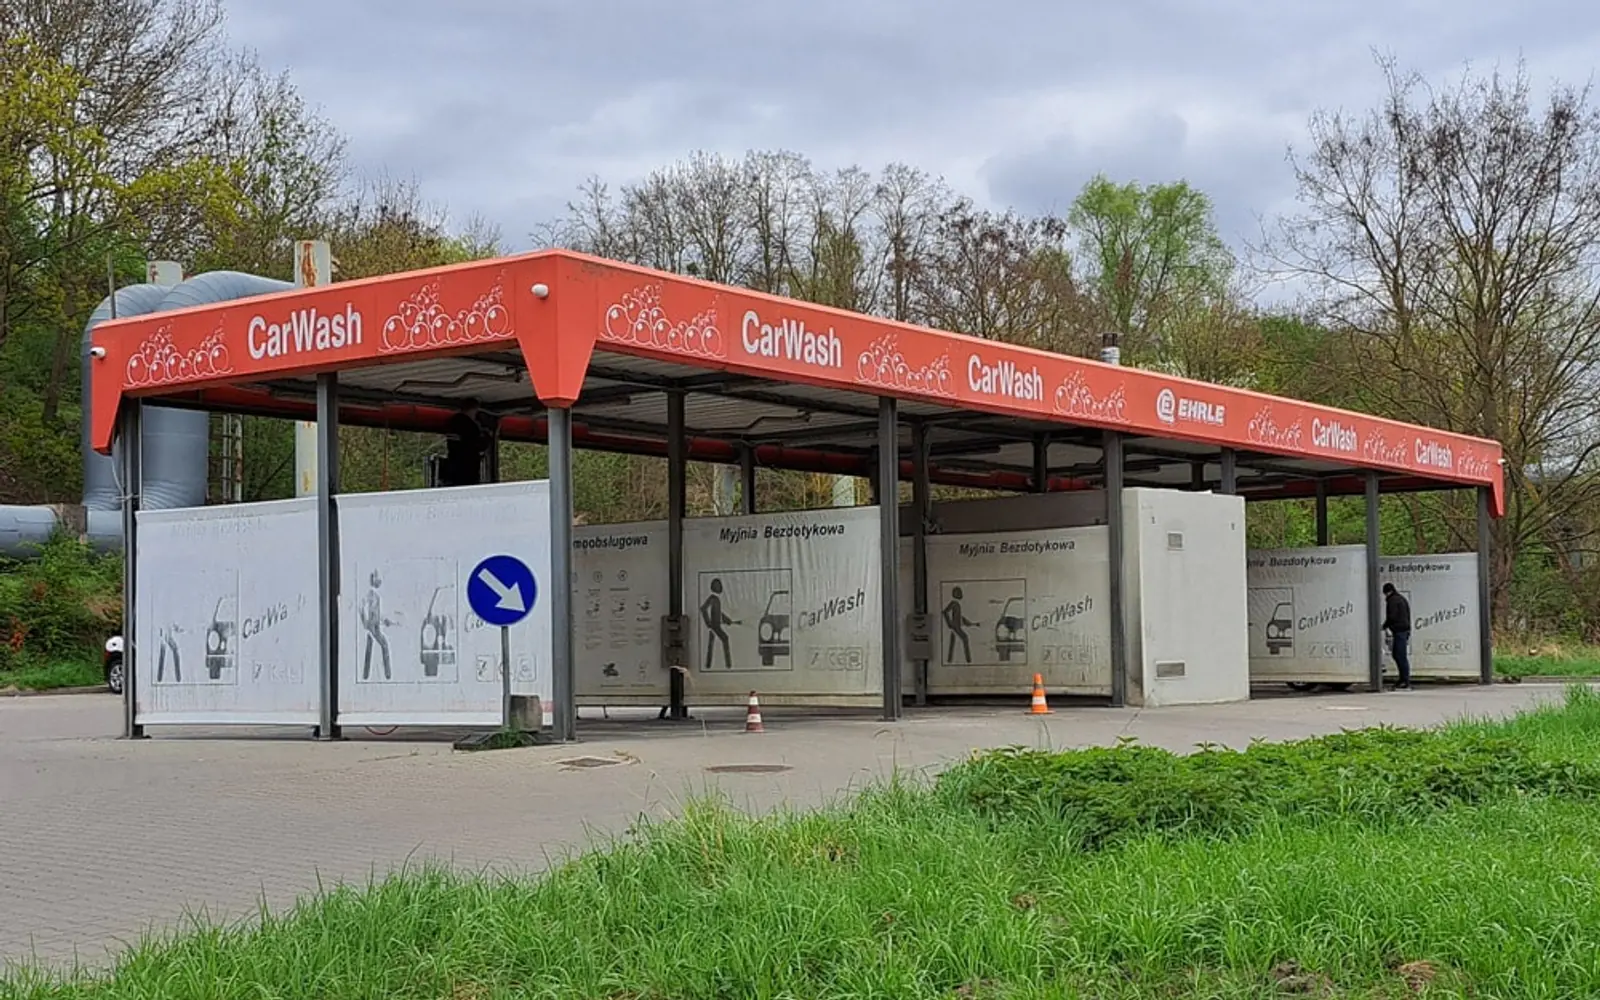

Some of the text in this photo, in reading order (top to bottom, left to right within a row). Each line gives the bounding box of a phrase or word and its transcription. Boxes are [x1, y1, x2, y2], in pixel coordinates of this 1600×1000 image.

[248, 302, 362, 360] CarWash
[742, 310, 842, 368] CarWash
[967, 354, 1044, 402] CarWash
[1178, 398, 1225, 424] EHRLE
[1312, 417, 1358, 452] CarWash
[1415, 437, 1453, 468] CarWash
[719, 523, 845, 543] Myjnia Bezdotykowa
[959, 540, 1076, 557] Myjnia Bezdotykowa
[797, 588, 866, 631] CarWash
[1031, 595, 1093, 631] CarWash
[1297, 600, 1354, 631] CarWash
[1414, 604, 1466, 630] CarWash
